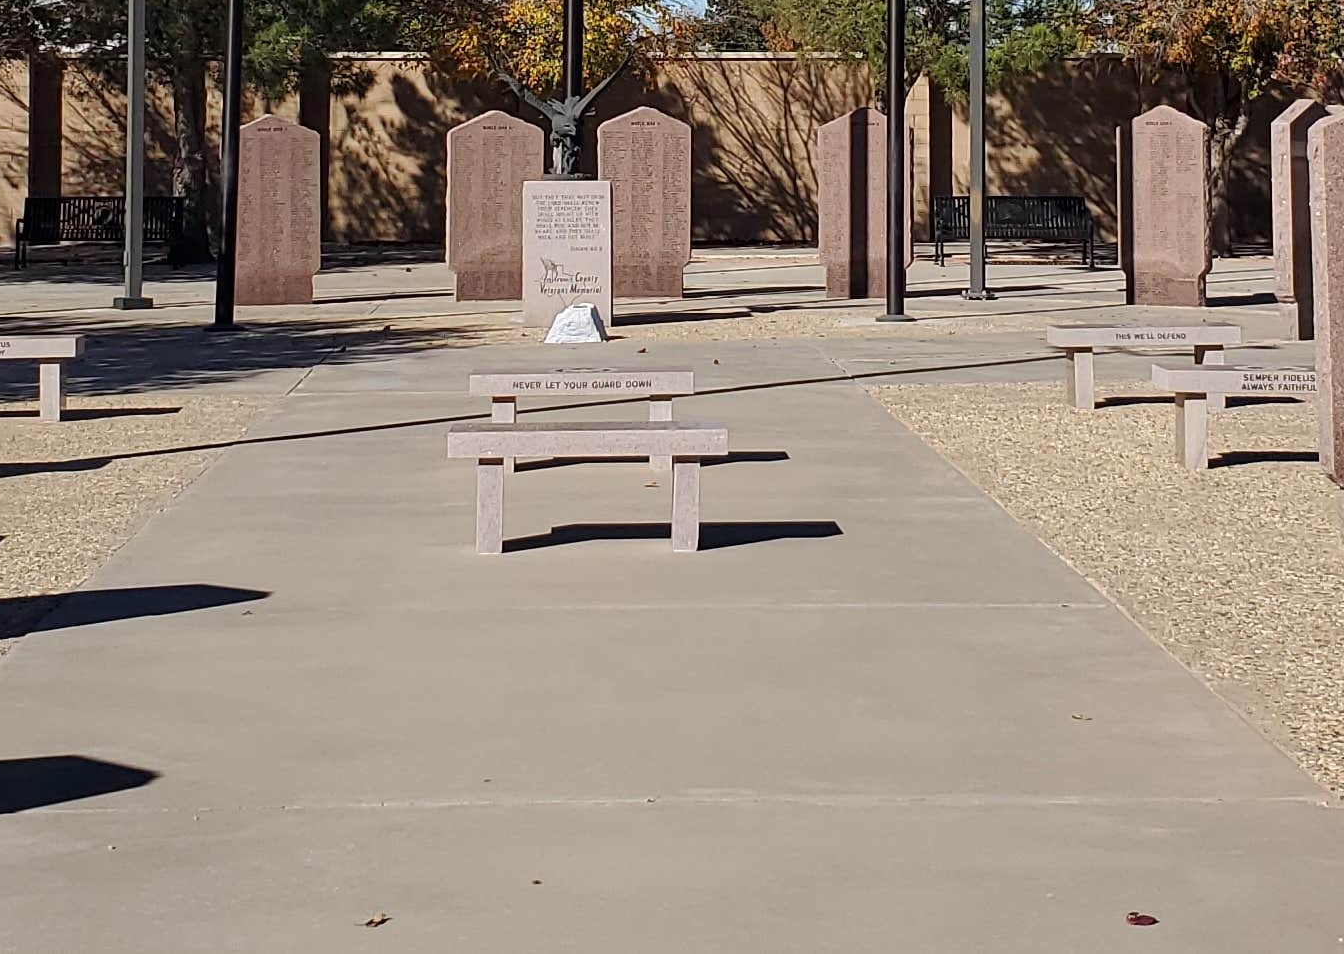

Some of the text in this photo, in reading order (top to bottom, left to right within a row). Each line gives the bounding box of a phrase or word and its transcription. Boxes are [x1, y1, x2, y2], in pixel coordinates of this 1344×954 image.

[576, 271, 599, 283] County
[570, 284, 602, 294] Memorial
[1243, 373, 1316, 382] SEMPER FIDELIS
[512, 380, 652, 390] NEVER LET YOUR GUARD DOWN
[1242, 383, 1317, 391] ALWAYS FAITHFUL
